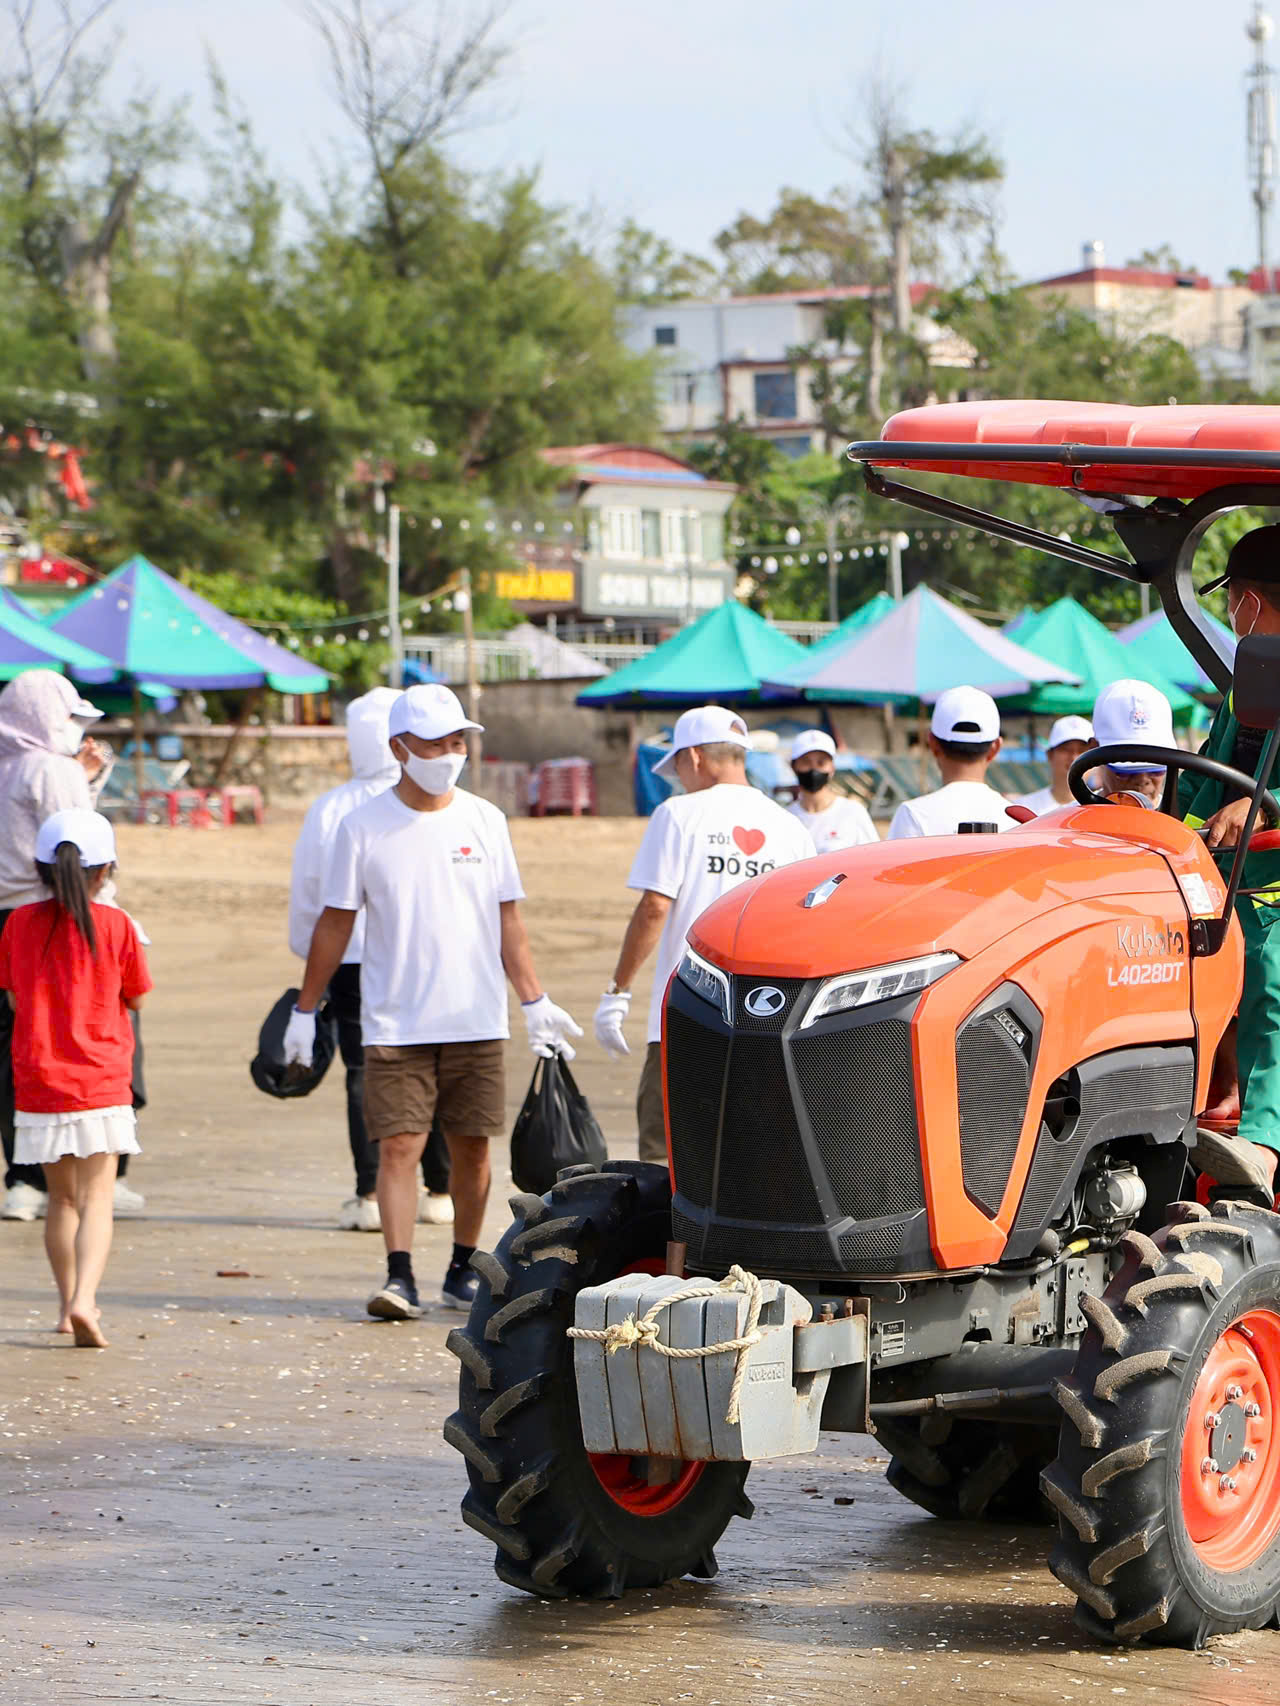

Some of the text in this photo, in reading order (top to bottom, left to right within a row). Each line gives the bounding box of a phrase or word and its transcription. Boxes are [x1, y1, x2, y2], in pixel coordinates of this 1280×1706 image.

[707, 832, 731, 845] TÔI
[744, 859, 776, 878] SƠ
[1117, 922, 1184, 958] Kubota
[1107, 961, 1185, 987] L4028DT
